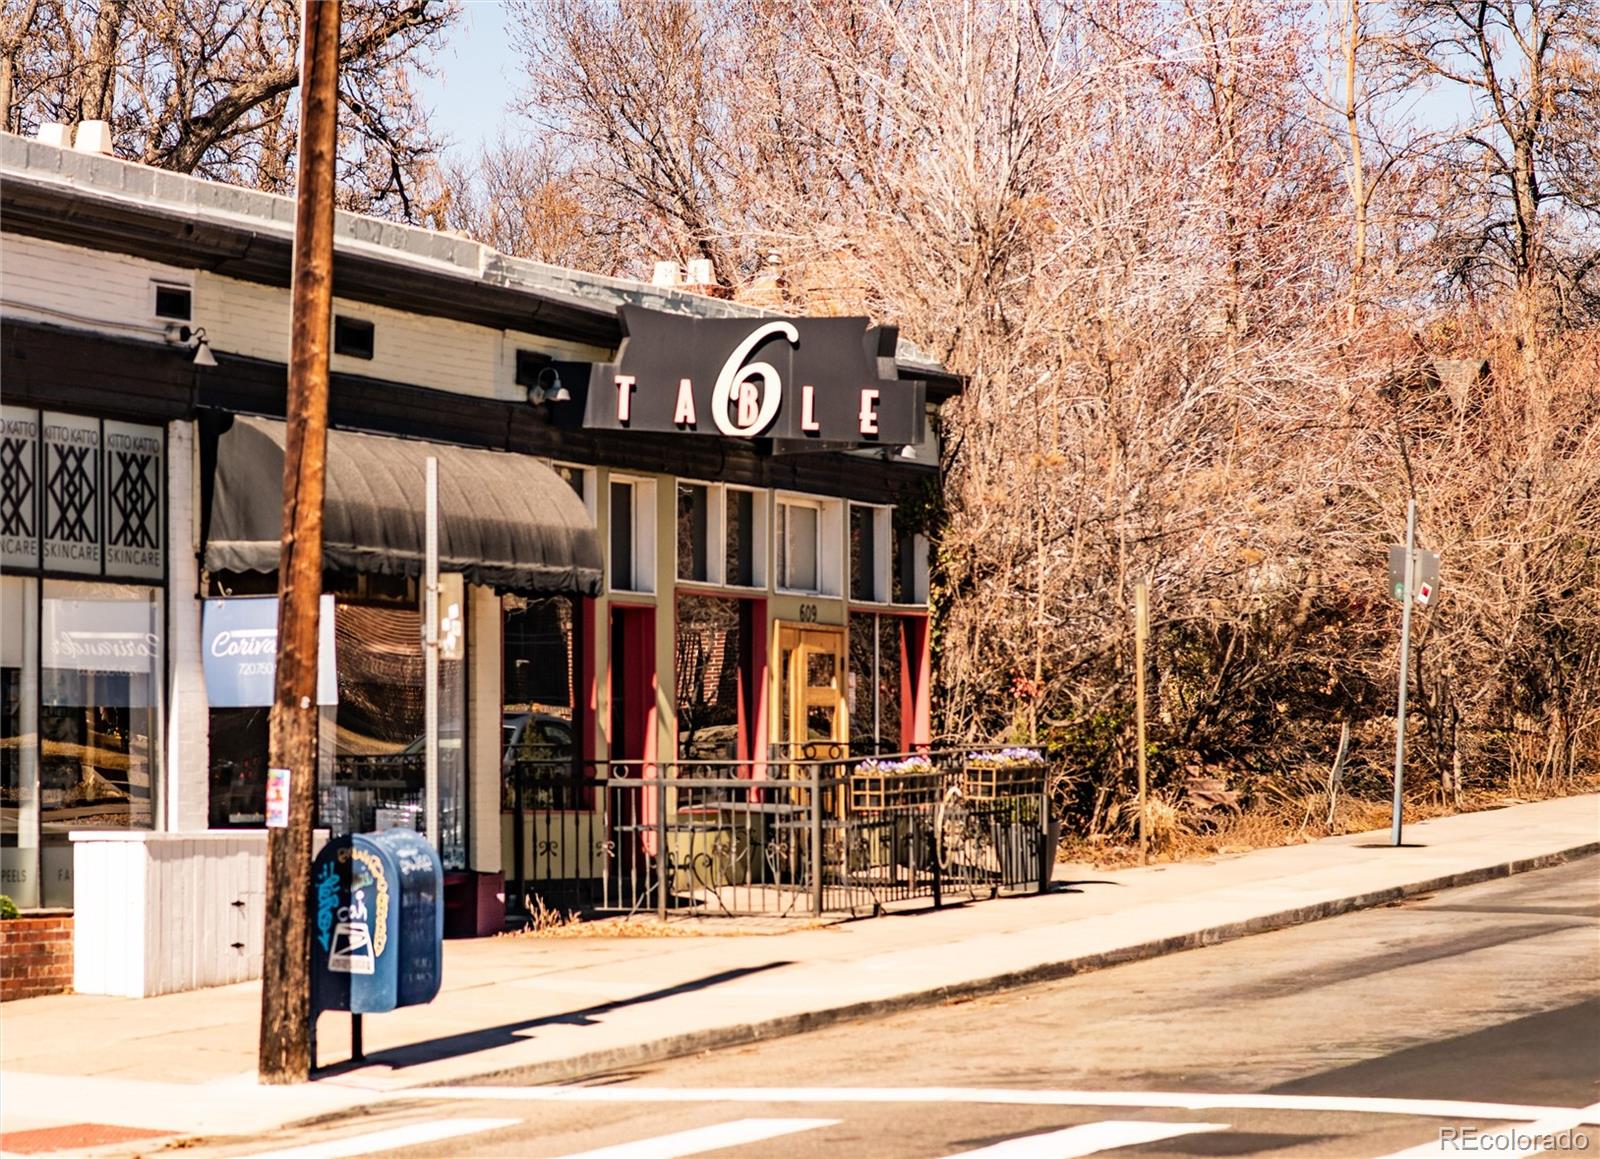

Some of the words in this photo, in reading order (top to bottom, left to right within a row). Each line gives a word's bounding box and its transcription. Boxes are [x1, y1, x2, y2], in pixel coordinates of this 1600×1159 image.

[712, 321, 799, 437] 6
[44, 425, 69, 441] KITTO
[71, 428, 98, 445] KATTO
[107, 433, 131, 449] KITTO
[132, 435, 160, 452] KATTO
[44, 542, 99, 561] SKINCARE
[107, 548, 160, 567] SKINCARE
[800, 604, 817, 622] 609
